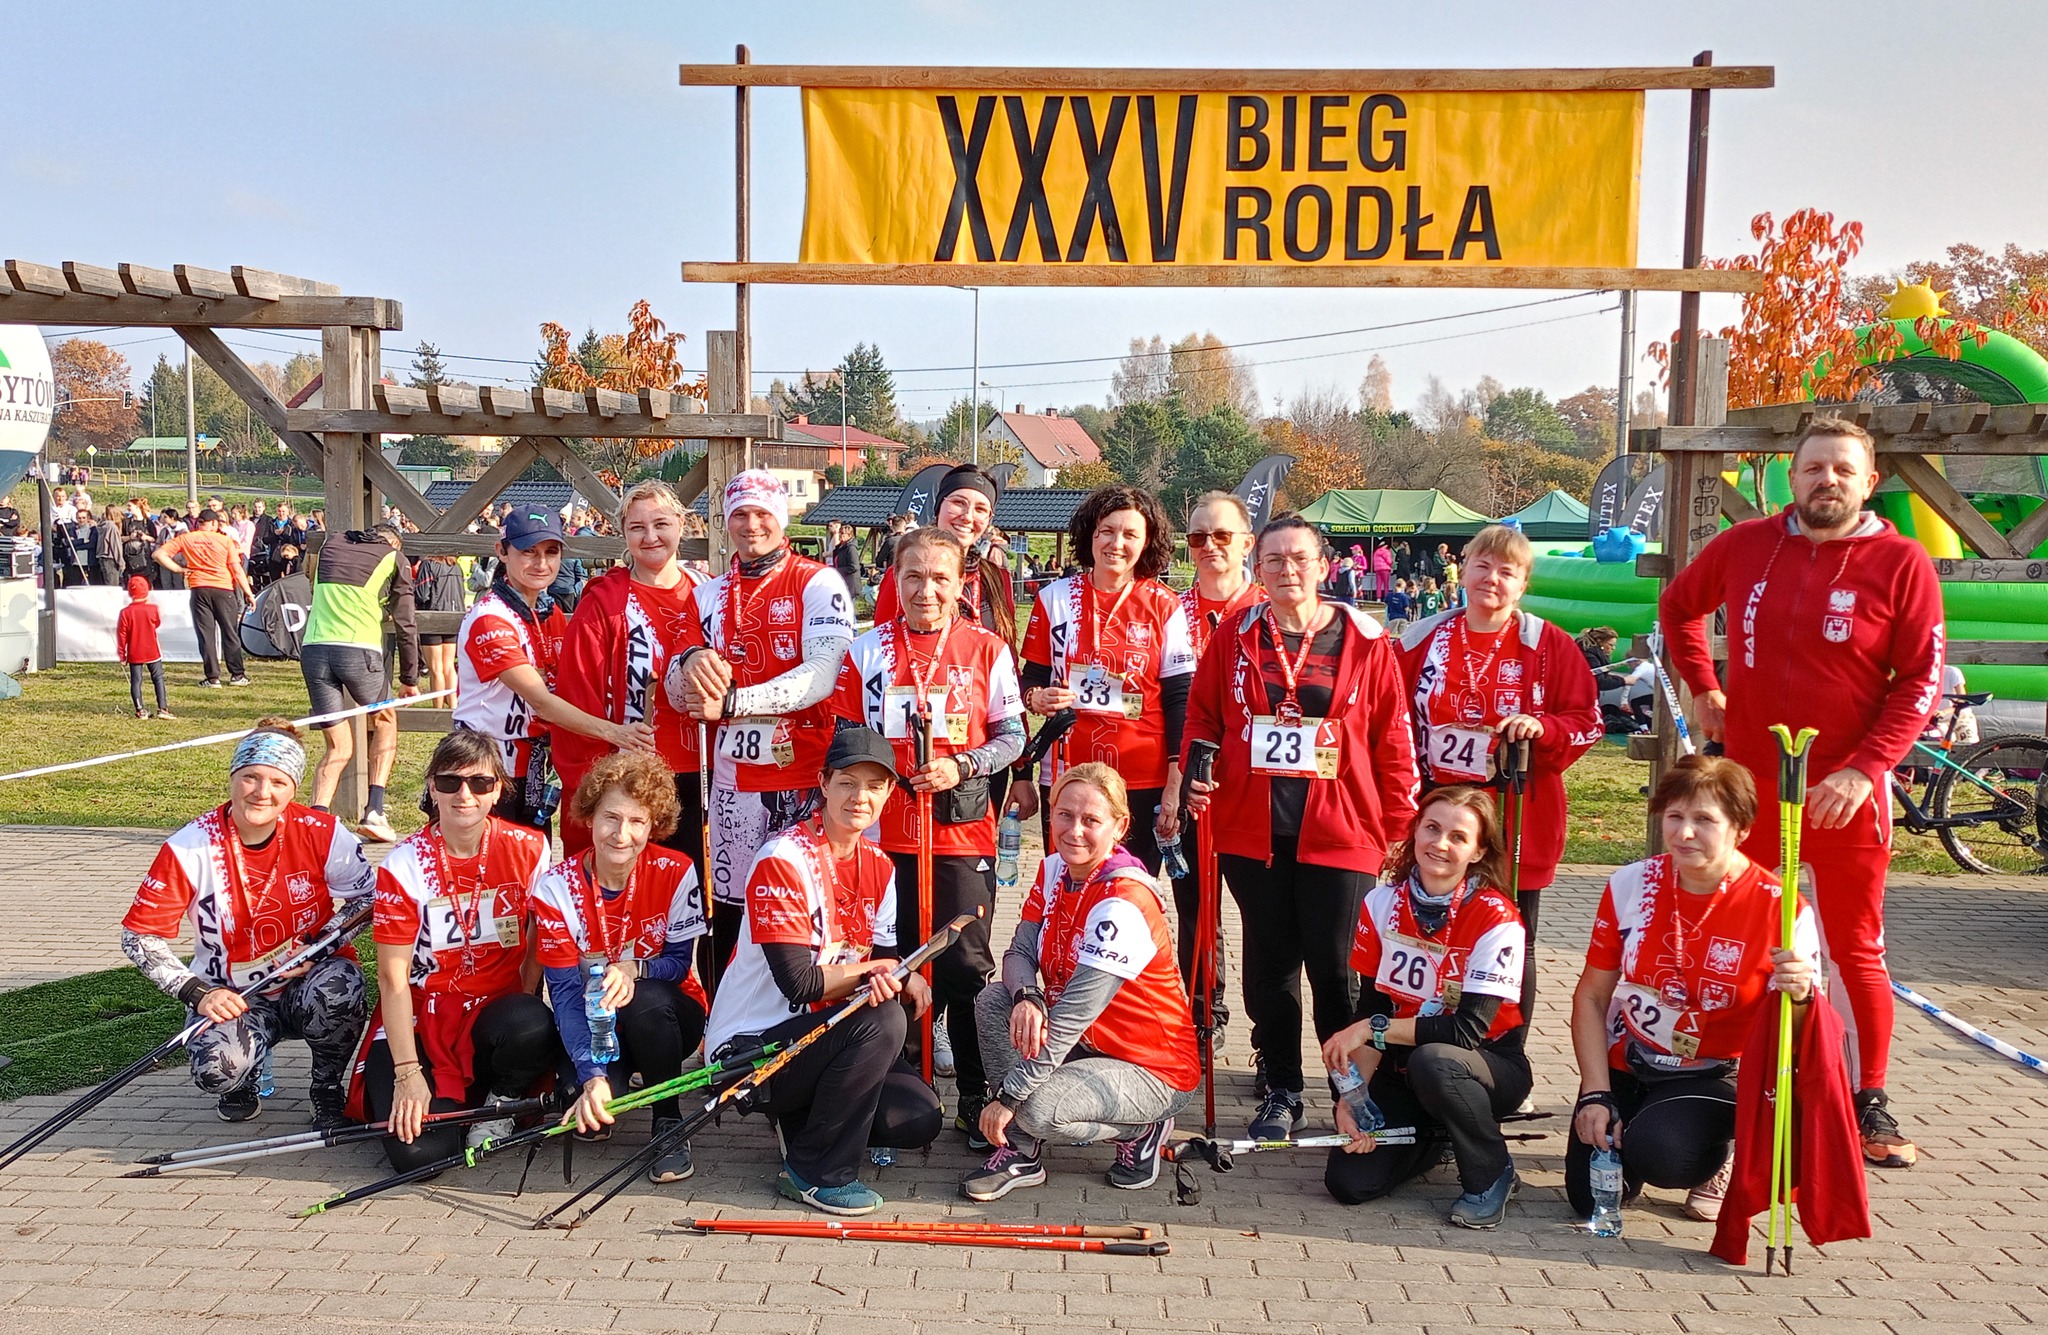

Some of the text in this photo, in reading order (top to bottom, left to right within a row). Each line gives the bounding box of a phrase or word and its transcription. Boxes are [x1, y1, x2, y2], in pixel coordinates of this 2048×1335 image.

[933, 93, 1406, 263] XXXV BIEG
[1223, 185, 1502, 262] RODŁA
[0, 372, 54, 409] YTÓW
[1372, 524, 1415, 533] GOSTKOWO
[1427, 597, 1436, 609] 6
[1744, 580, 1767, 669] BASZTA
[732, 730, 761, 760] 38
[1266, 731, 1302, 764] 23
[1440, 734, 1476, 767] 24
[714, 834, 732, 899] CODY
[536, 915, 566, 930] NWF
[668, 914, 705, 932] iSSK
[1079, 942, 1128, 964] SSKRA
[1389, 951, 1427, 990] 26
[1627, 994, 1661, 1036] 22
[1655, 1055, 1682, 1067] PROFI
